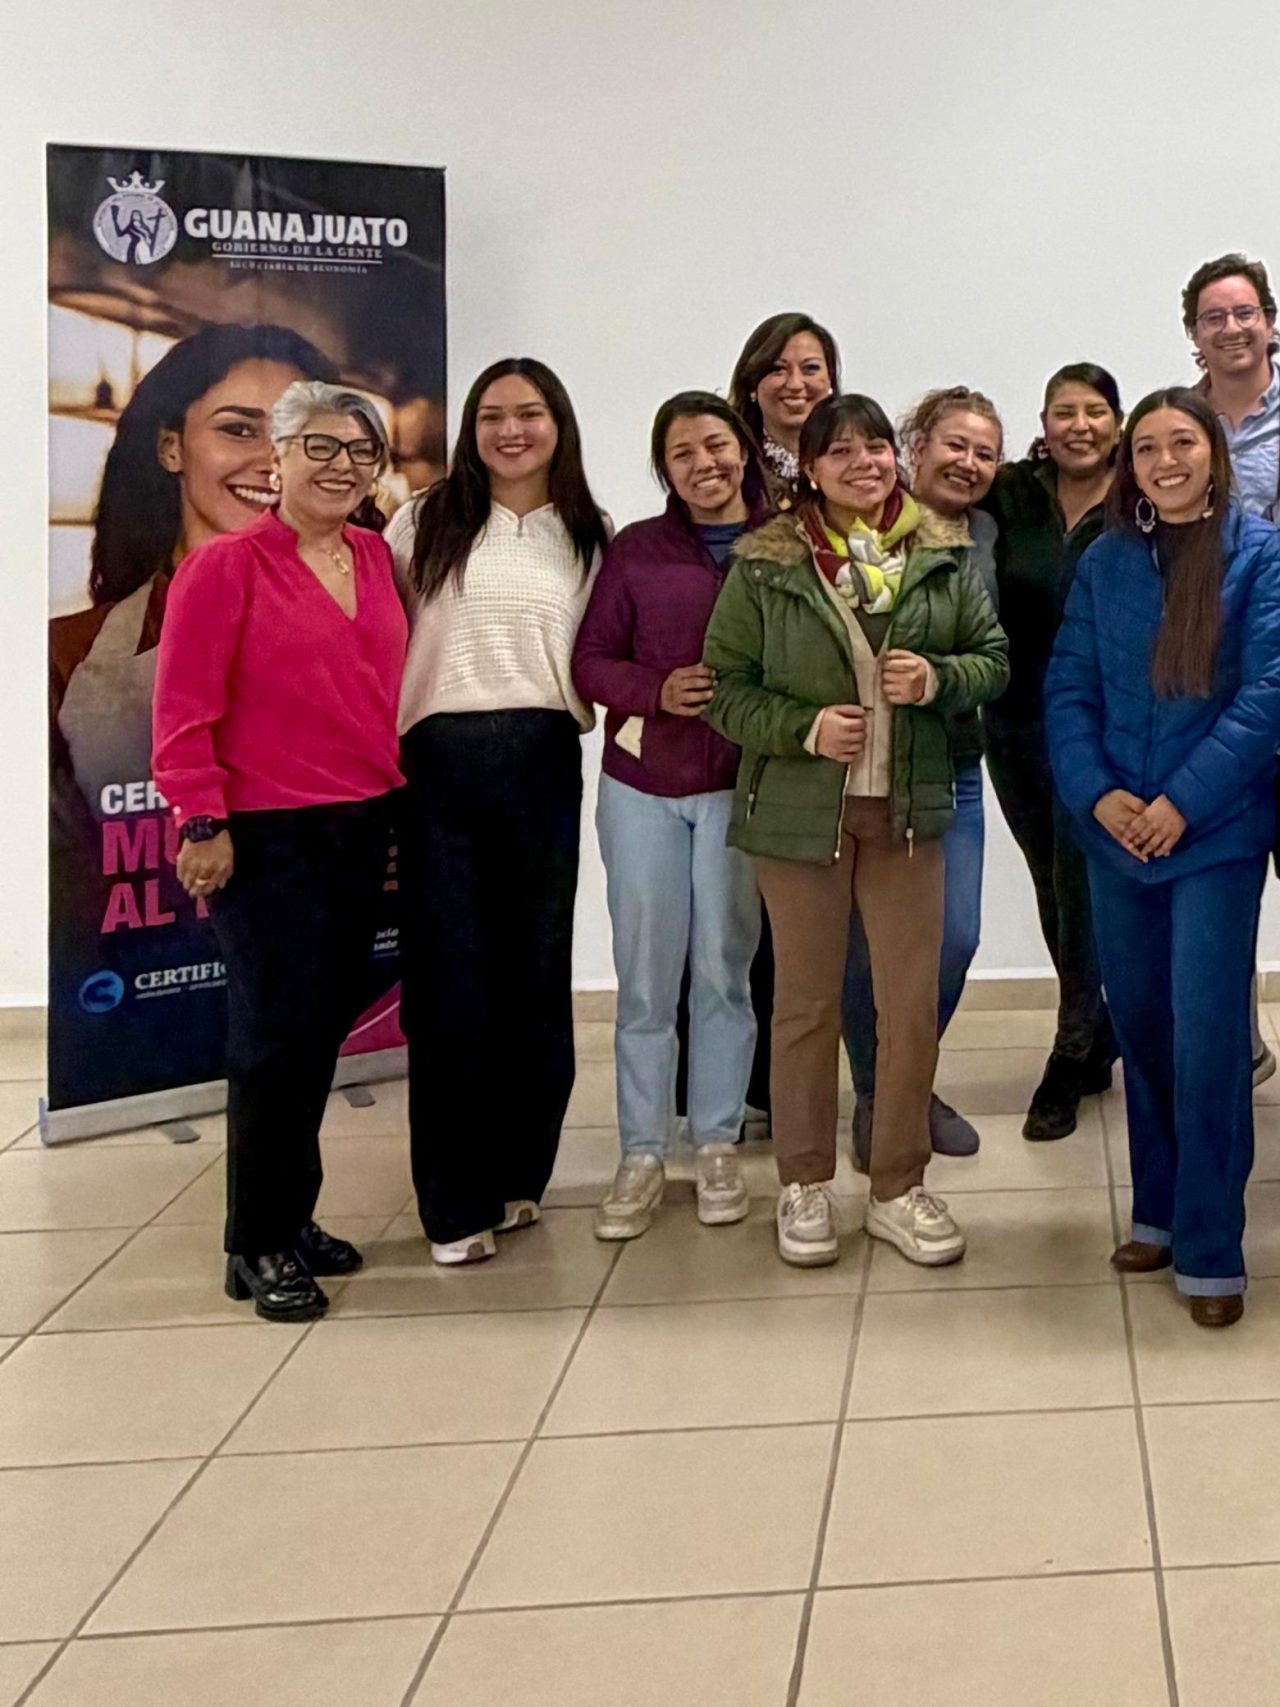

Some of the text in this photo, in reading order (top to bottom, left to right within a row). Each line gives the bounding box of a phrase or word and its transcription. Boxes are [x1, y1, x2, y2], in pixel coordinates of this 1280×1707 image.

[184, 208, 408, 247] GUANAJUATO
[211, 241, 383, 259] GOBIERNO DE LA GENTE
[101, 878, 176, 934] AL
